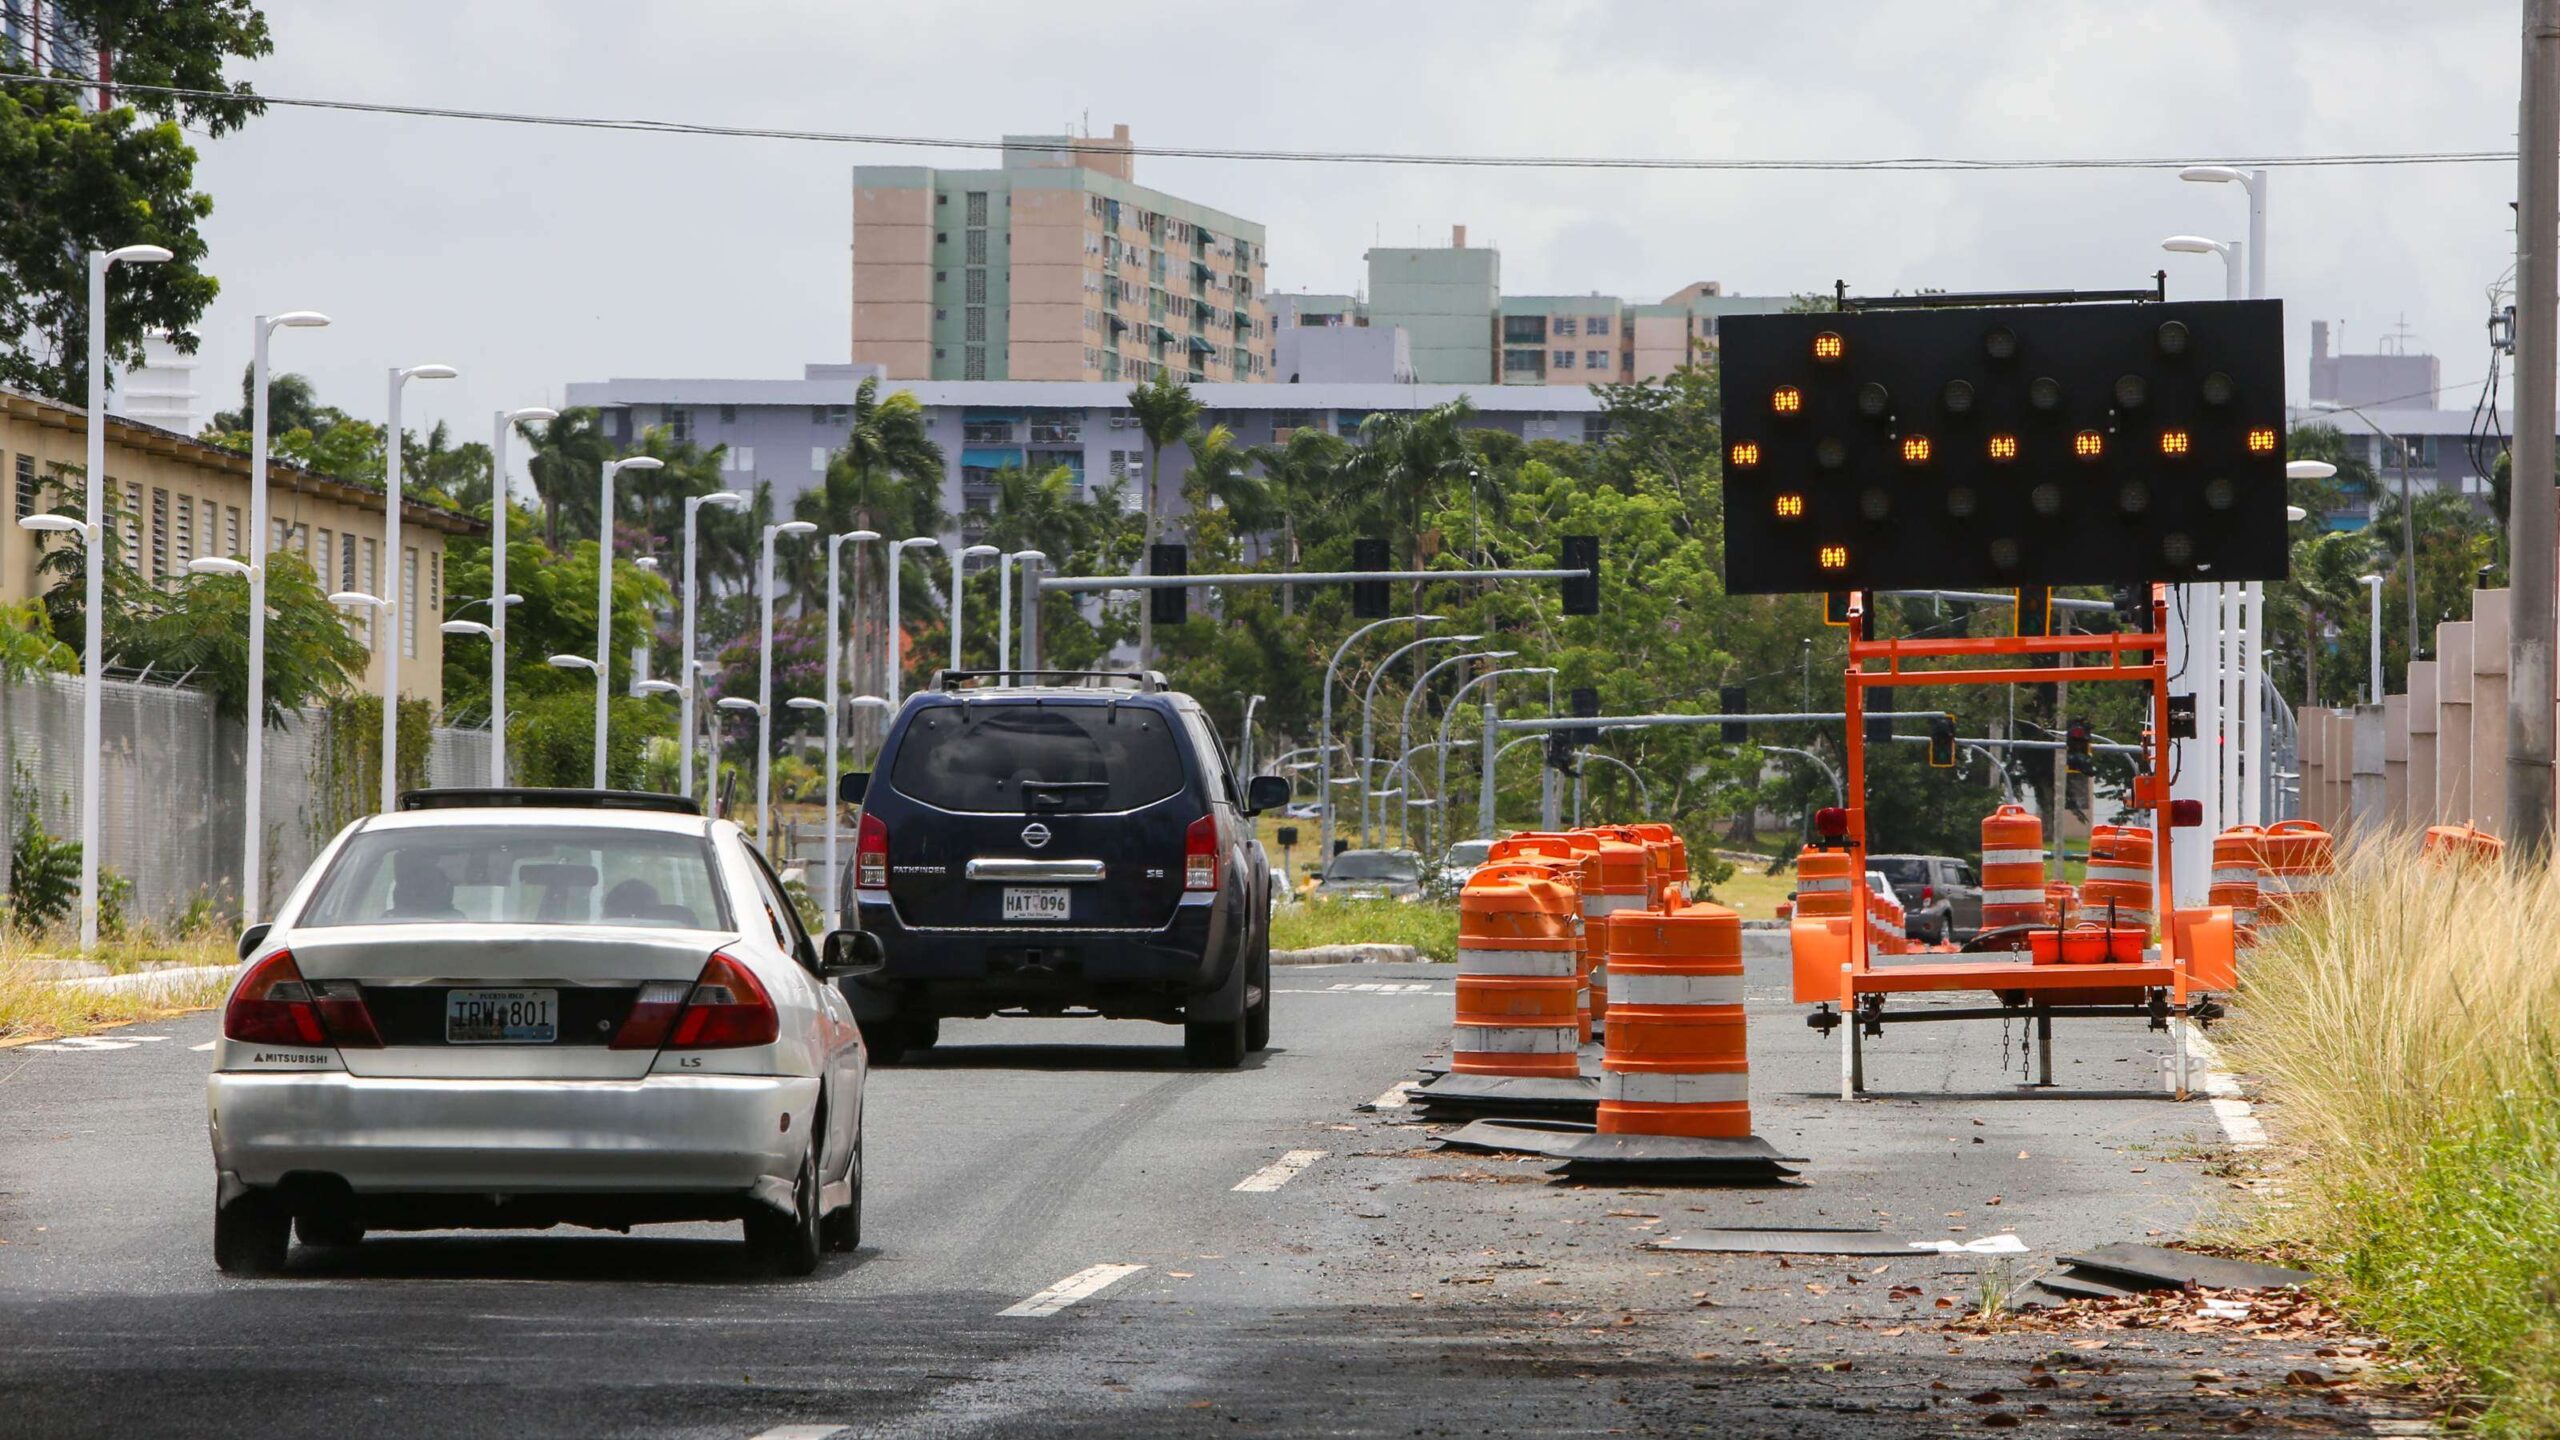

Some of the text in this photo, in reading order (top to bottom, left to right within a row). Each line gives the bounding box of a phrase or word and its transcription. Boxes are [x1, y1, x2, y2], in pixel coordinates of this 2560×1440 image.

[893, 866, 947, 874] PATHFINDER
[1146, 869, 1164, 878] SE
[1006, 896, 1066, 911] HAT 096
[510, 1001, 549, 1026] 801
[265, 1053, 328, 1064] MITSUBISHI
[680, 1057, 702, 1068] LS
